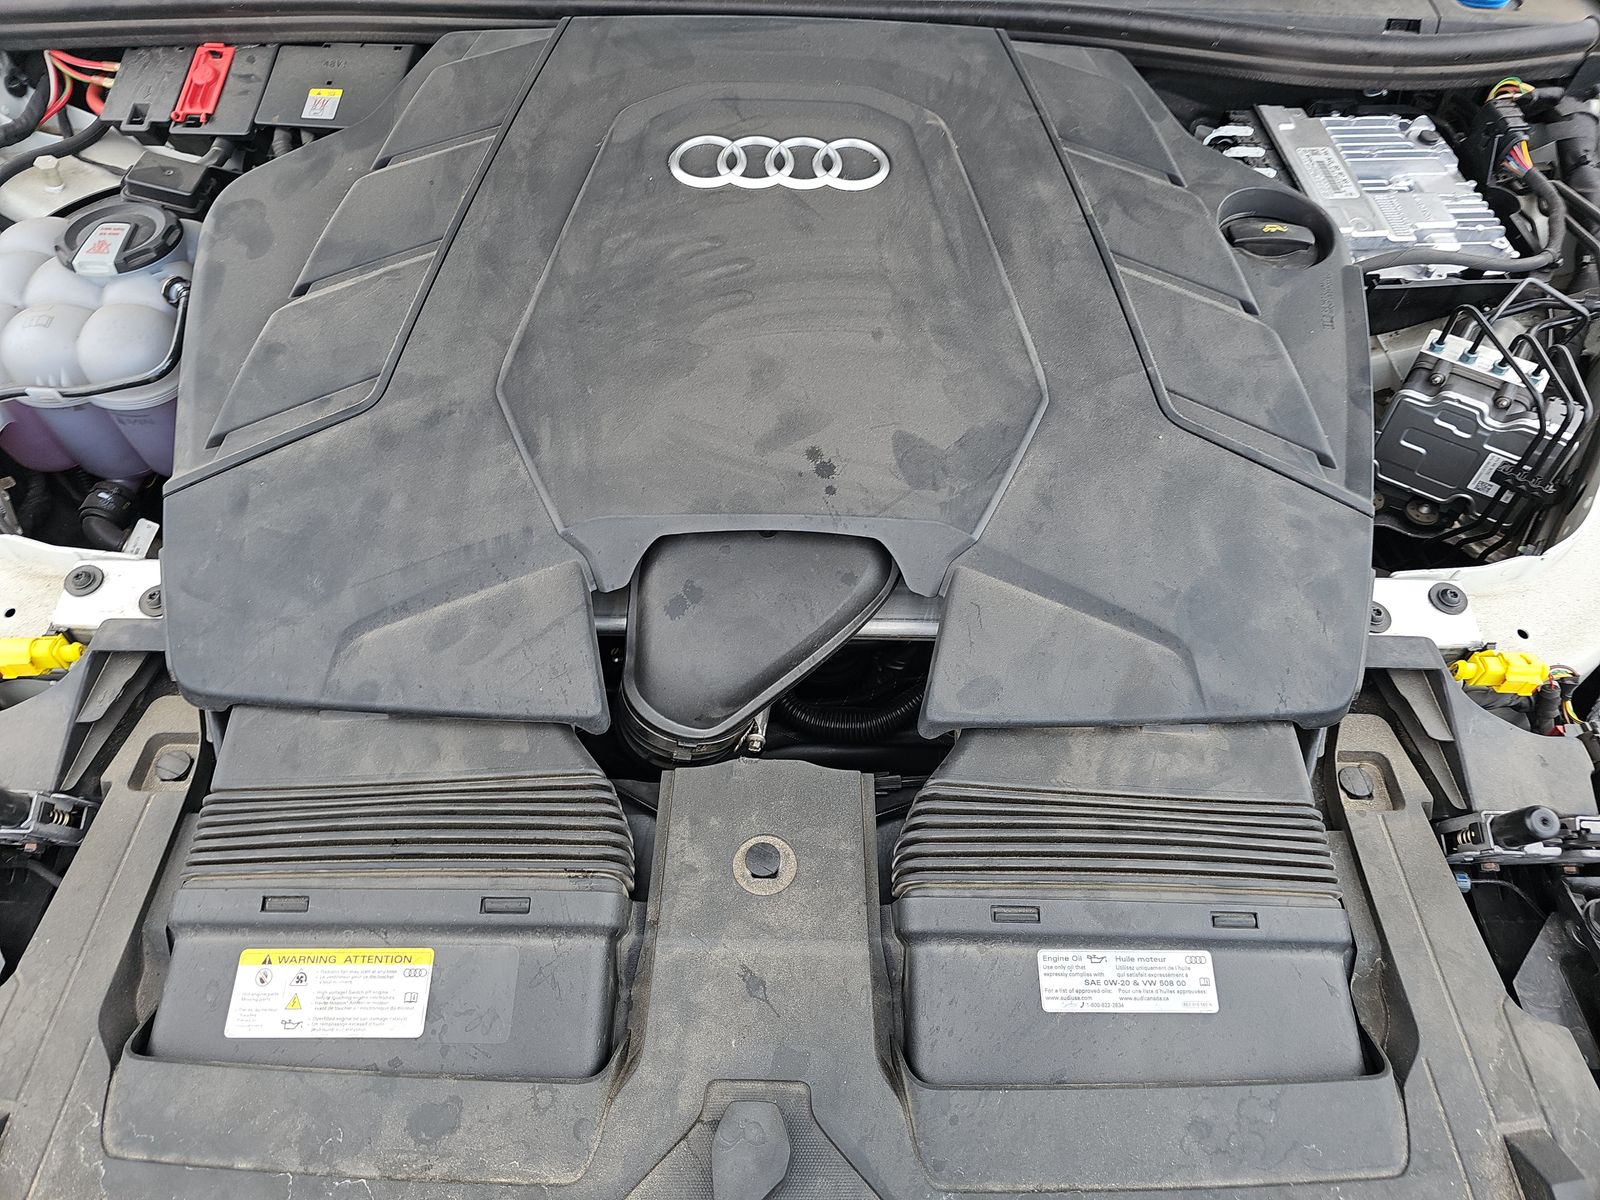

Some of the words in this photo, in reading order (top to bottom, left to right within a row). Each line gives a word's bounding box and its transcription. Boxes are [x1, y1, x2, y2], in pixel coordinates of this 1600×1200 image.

[278, 955, 337, 964] WARNING
[344, 955, 413, 964] ATTENTION
[1043, 954, 1070, 963] Engine
[1072, 954, 1083, 962] Oil
[1115, 955, 1135, 963] Huile
[1103, 979, 1131, 987] 0W-20
[1141, 979, 1157, 987] VW
